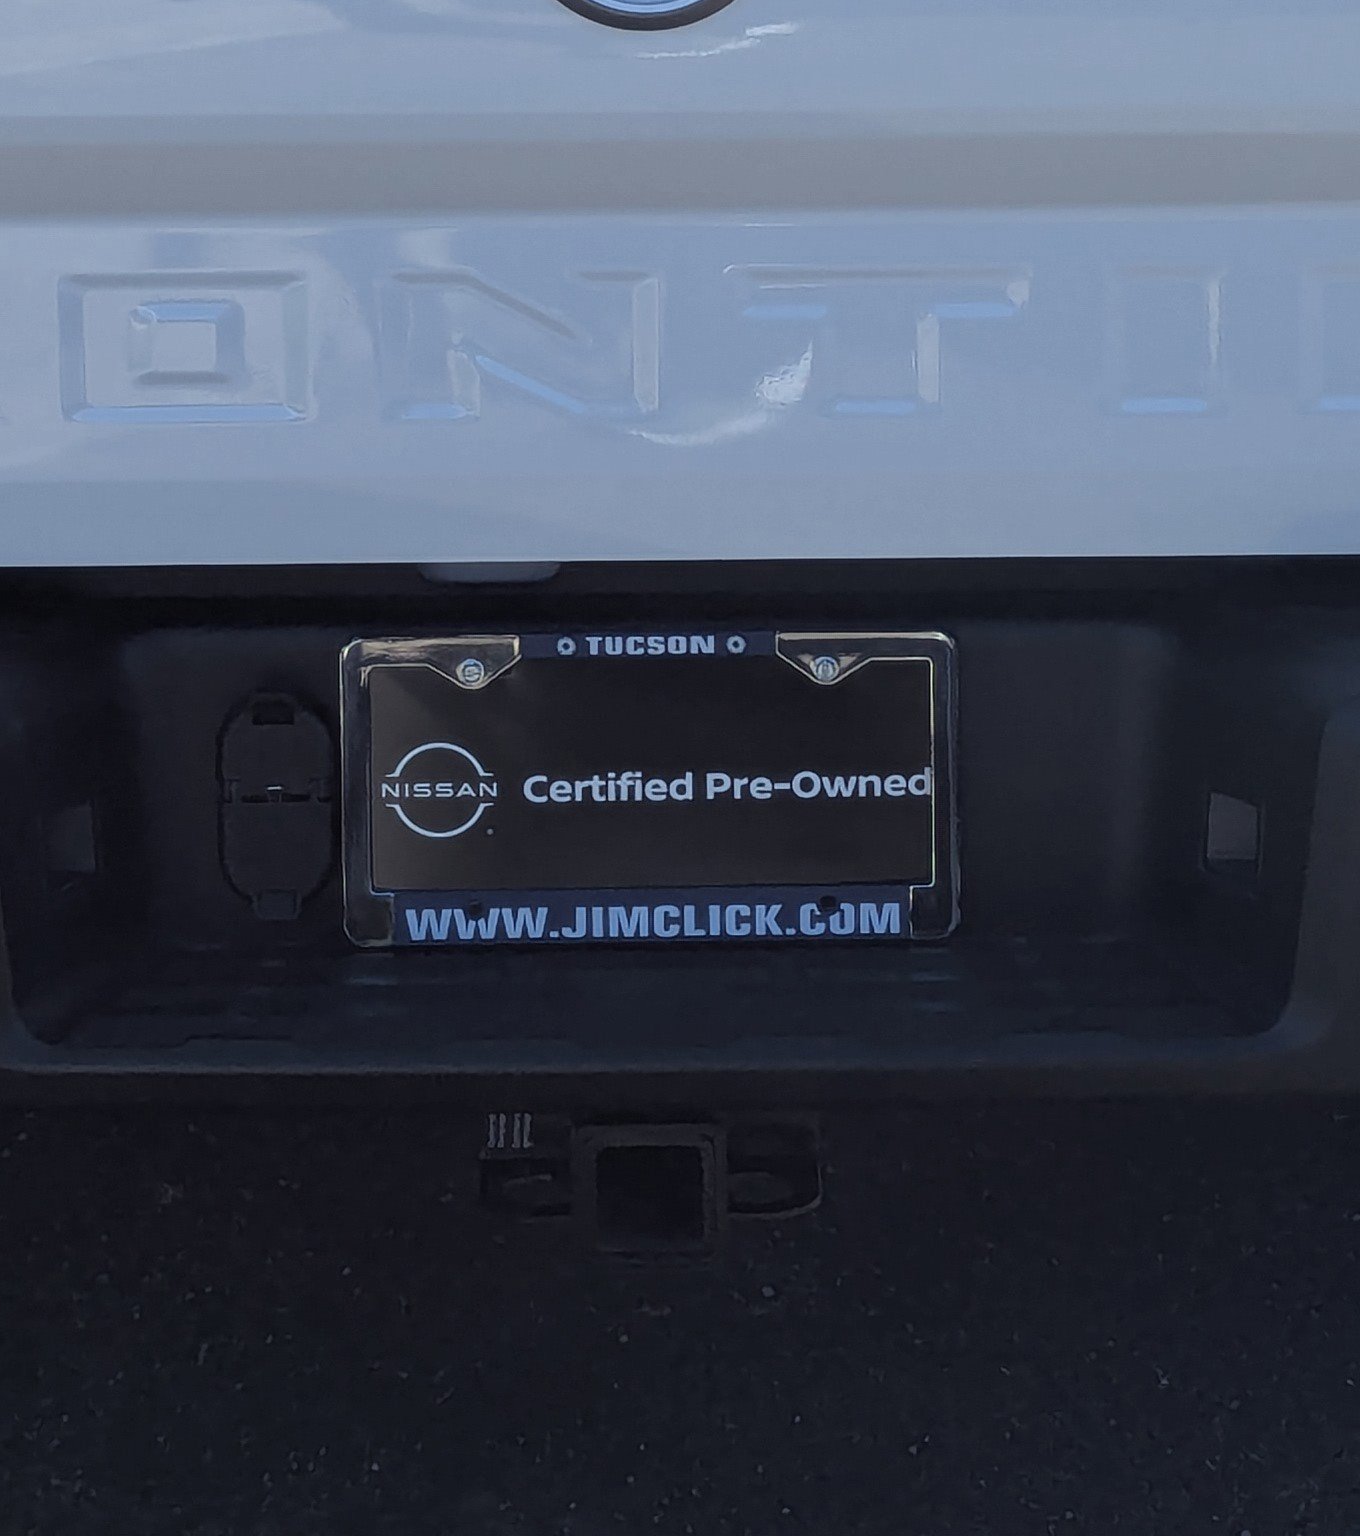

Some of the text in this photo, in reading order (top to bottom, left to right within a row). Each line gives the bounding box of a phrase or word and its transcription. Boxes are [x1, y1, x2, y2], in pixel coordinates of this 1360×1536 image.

[584, 634, 716, 656] TUCSON
[381, 781, 499, 799] NISSAN
[522, 766, 932, 804] Certified Pre-Owned
[405, 901, 901, 941] WWW.JIMCLICK.COM
